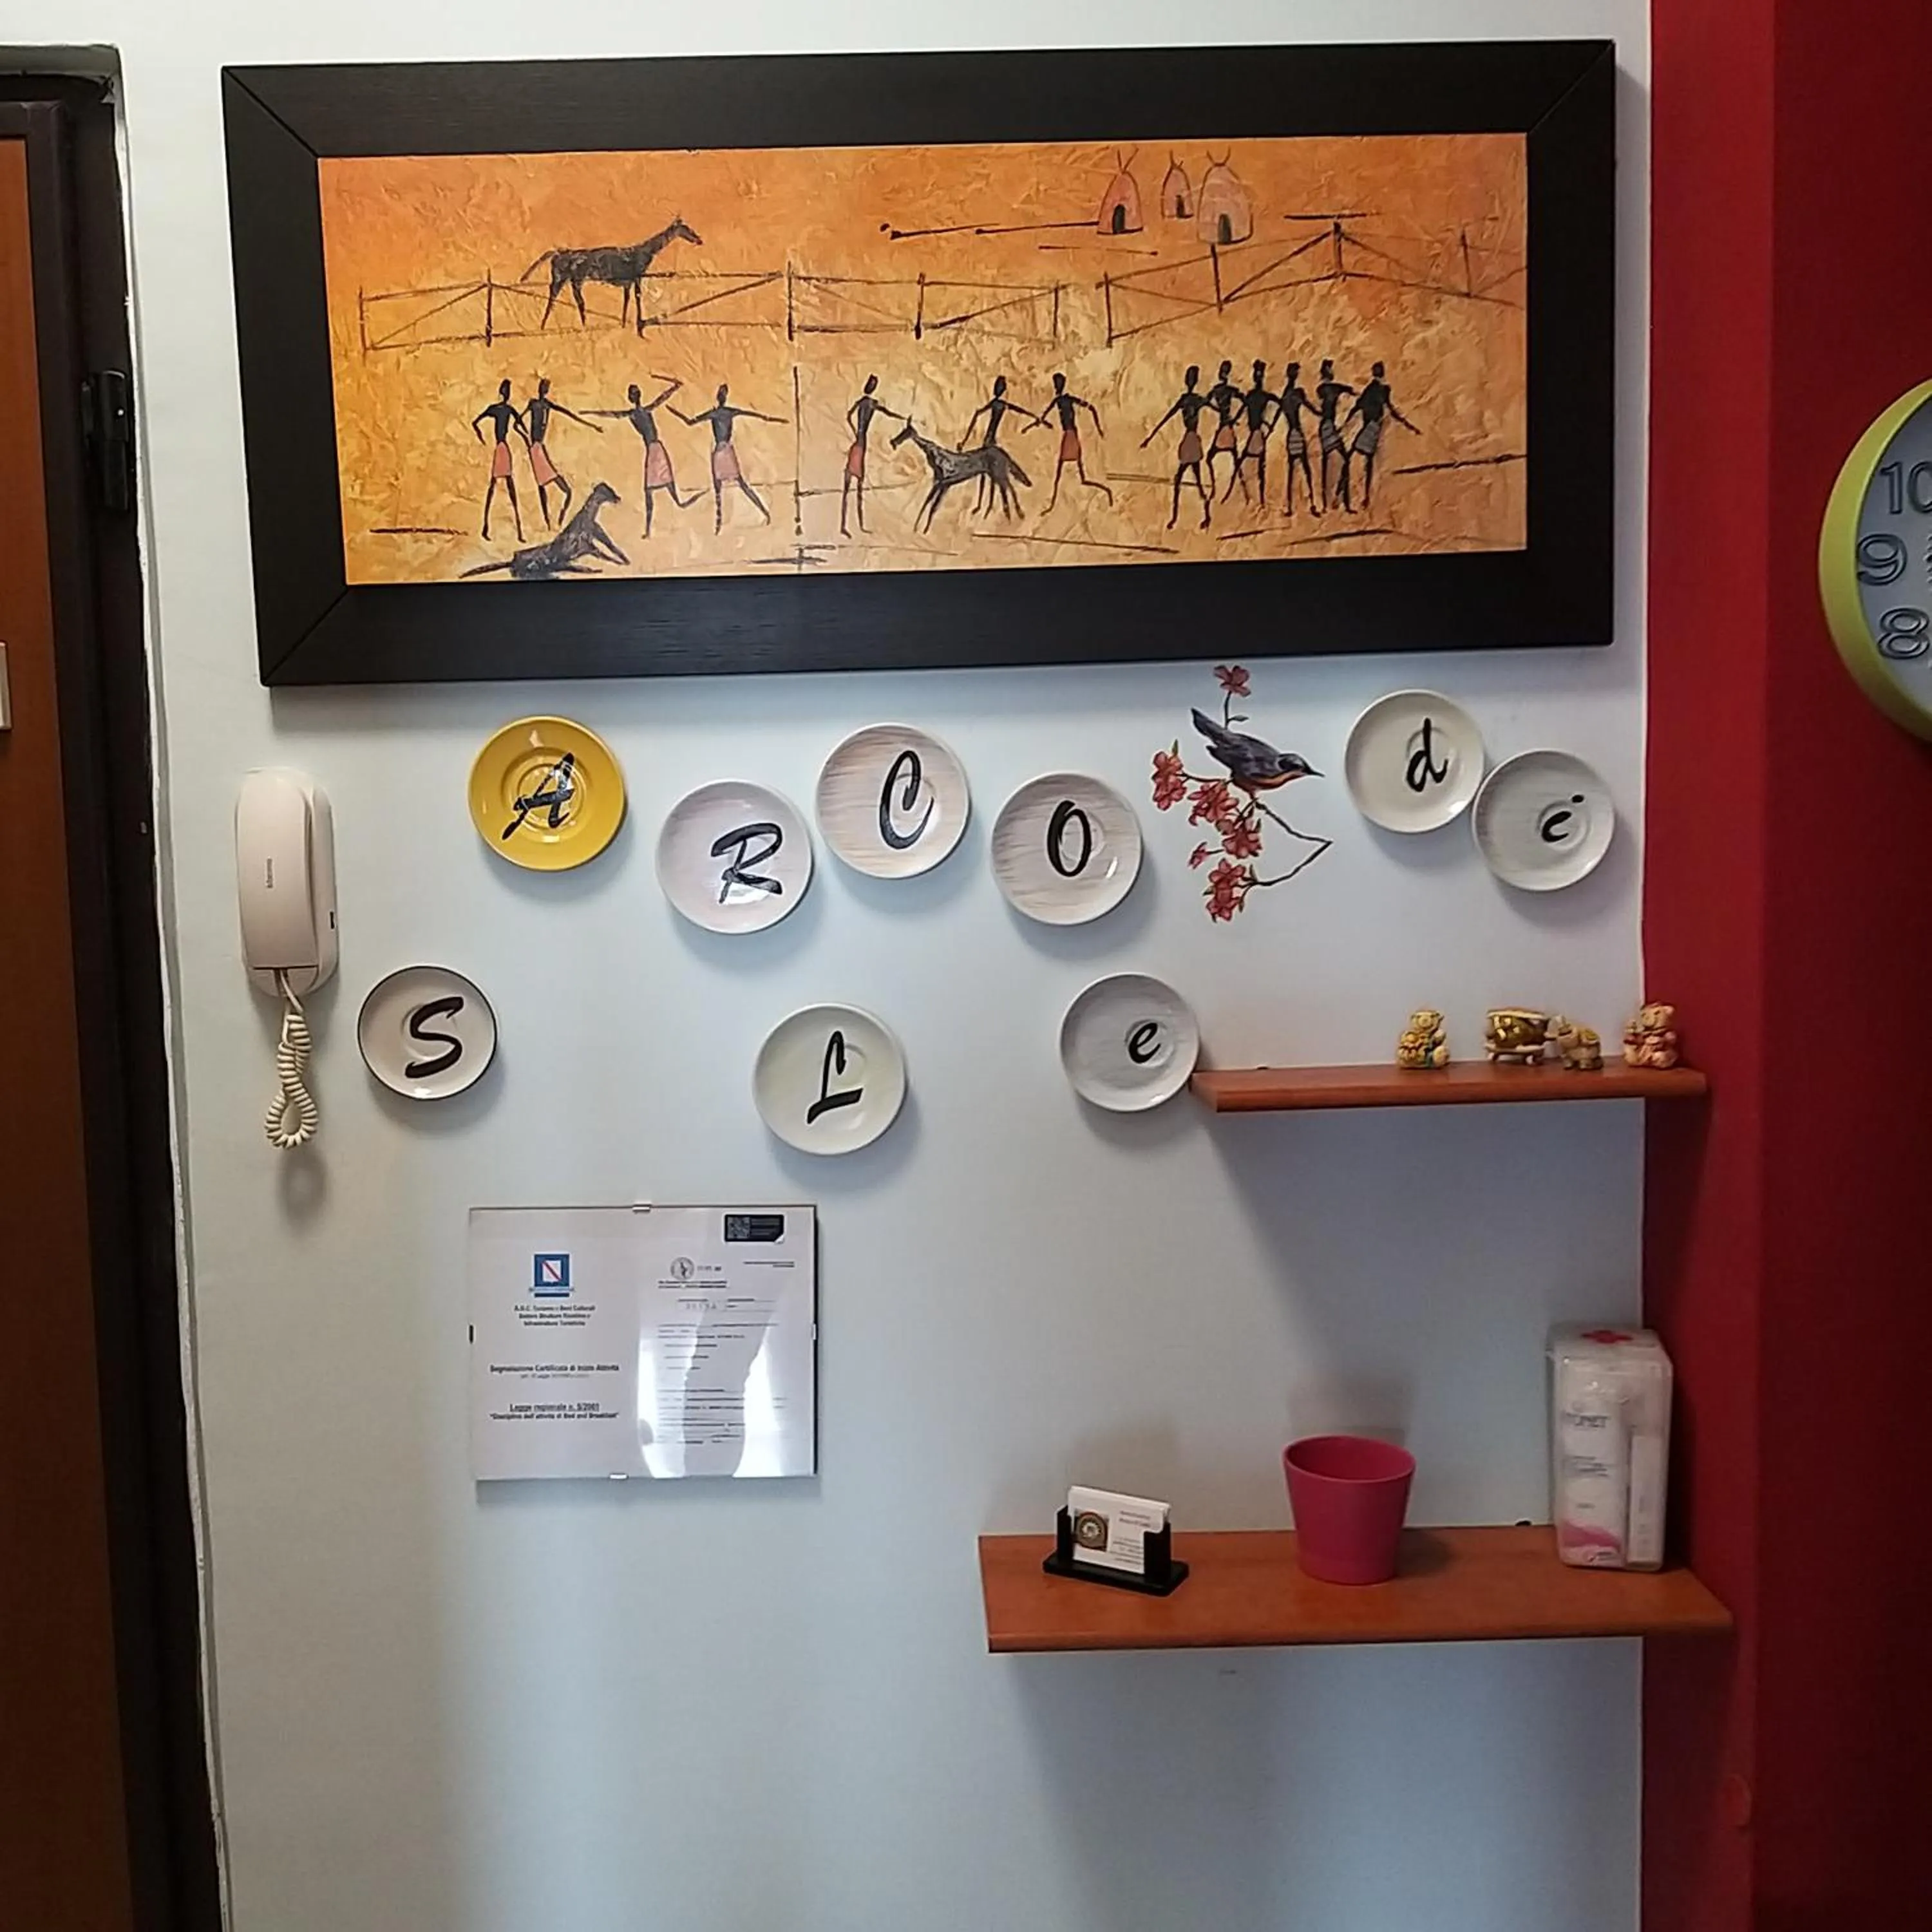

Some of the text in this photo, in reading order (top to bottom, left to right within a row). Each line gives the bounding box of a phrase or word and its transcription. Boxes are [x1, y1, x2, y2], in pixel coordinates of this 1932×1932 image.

[1857, 533, 1908, 586] 9
[1878, 607, 1929, 659] 8
[501, 752, 575, 840] A
[710, 822, 783, 903] R
[878, 750, 934, 849] C
[1047, 800, 1092, 876] O
[1406, 717, 1448, 793] d
[405, 996, 1161, 1124] S L e
